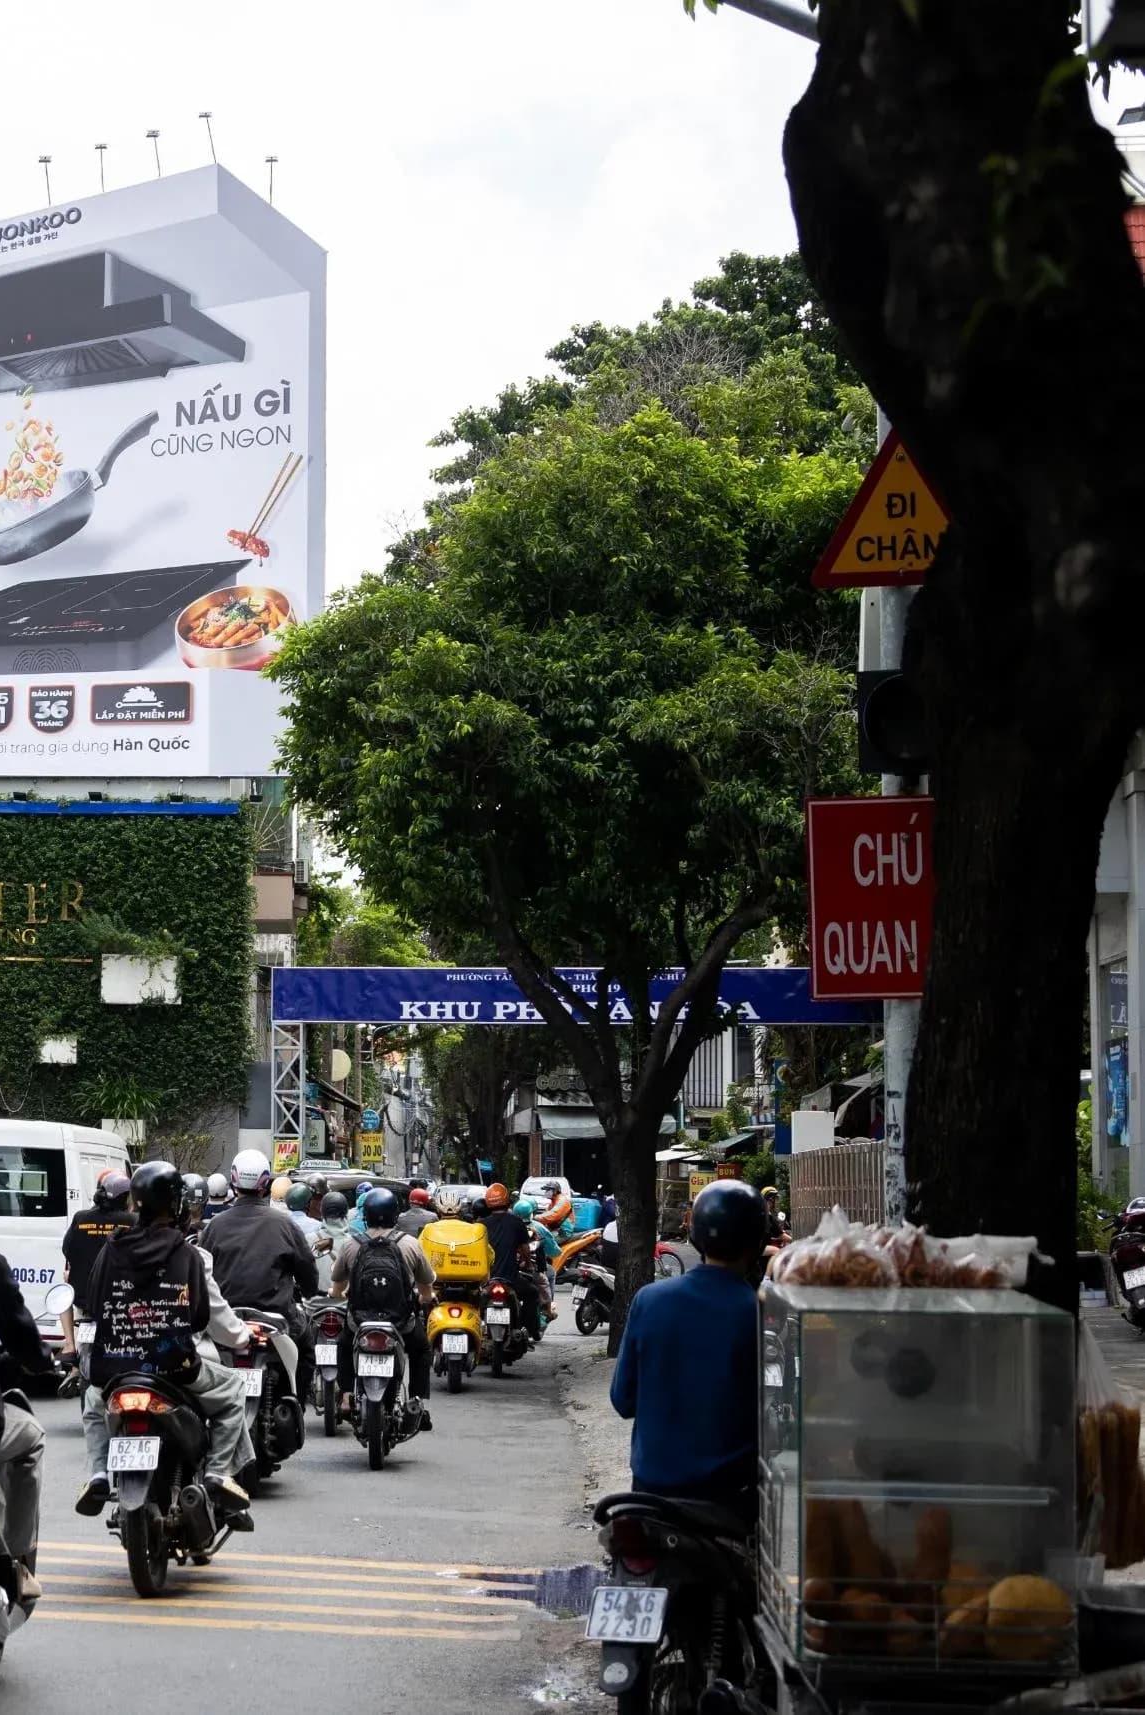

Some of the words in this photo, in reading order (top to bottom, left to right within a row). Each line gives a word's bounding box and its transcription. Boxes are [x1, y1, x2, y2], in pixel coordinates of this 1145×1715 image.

[175, 382, 242, 428] NẤU
[254, 379, 291, 417] GÌ
[151, 433, 214, 457] CŨNG
[220, 424, 291, 451] NGON
[885, 492, 917, 519] ĐI
[31, 688, 48, 697] BẢO
[49, 689, 73, 697] HÀNH
[34, 700, 69, 719] 36
[95, 709, 114, 720] LẮP
[117, 709, 137, 721] ĐẶT
[139, 707, 166, 719] MIỄN
[167, 708, 186, 719] PHÍ
[36, 719, 64, 727] THÁNG
[10, 741, 45, 756] trang
[49, 739, 68, 755] gia
[113, 738, 143, 751] Hàn
[148, 735, 190, 752] Quốc
[853, 812, 923, 887] CHÚ
[823, 920, 919, 975] QUAN
[399, 1001, 481, 1020] KHU
[277, 1143, 298, 1154] MIA
[117, 1440, 152, 1454] 62-AG
